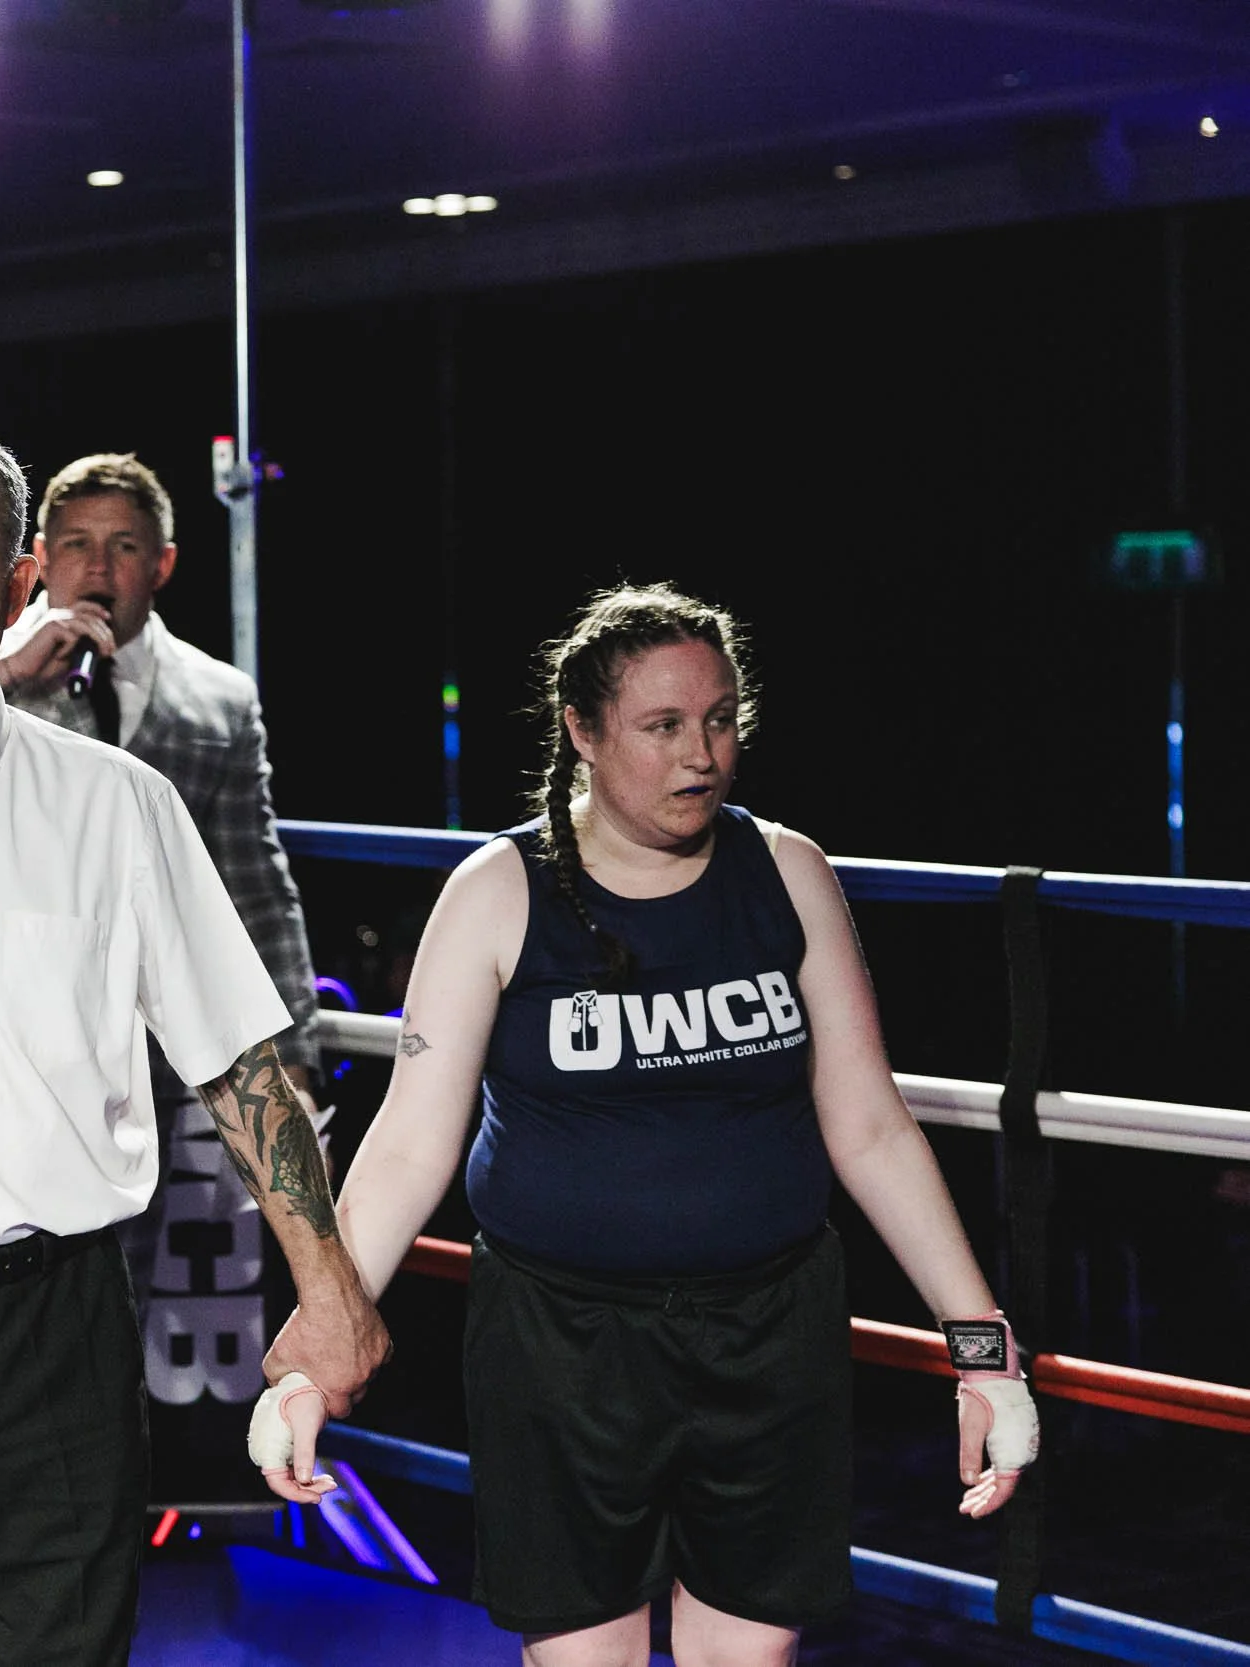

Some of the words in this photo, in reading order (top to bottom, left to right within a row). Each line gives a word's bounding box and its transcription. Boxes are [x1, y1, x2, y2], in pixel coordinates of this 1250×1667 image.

[549, 970, 802, 1071] UWCB
[635, 1055, 684, 1069] ULTRA
[684, 1048, 733, 1065] WHITE
[734, 1039, 782, 1057] COLLAR
